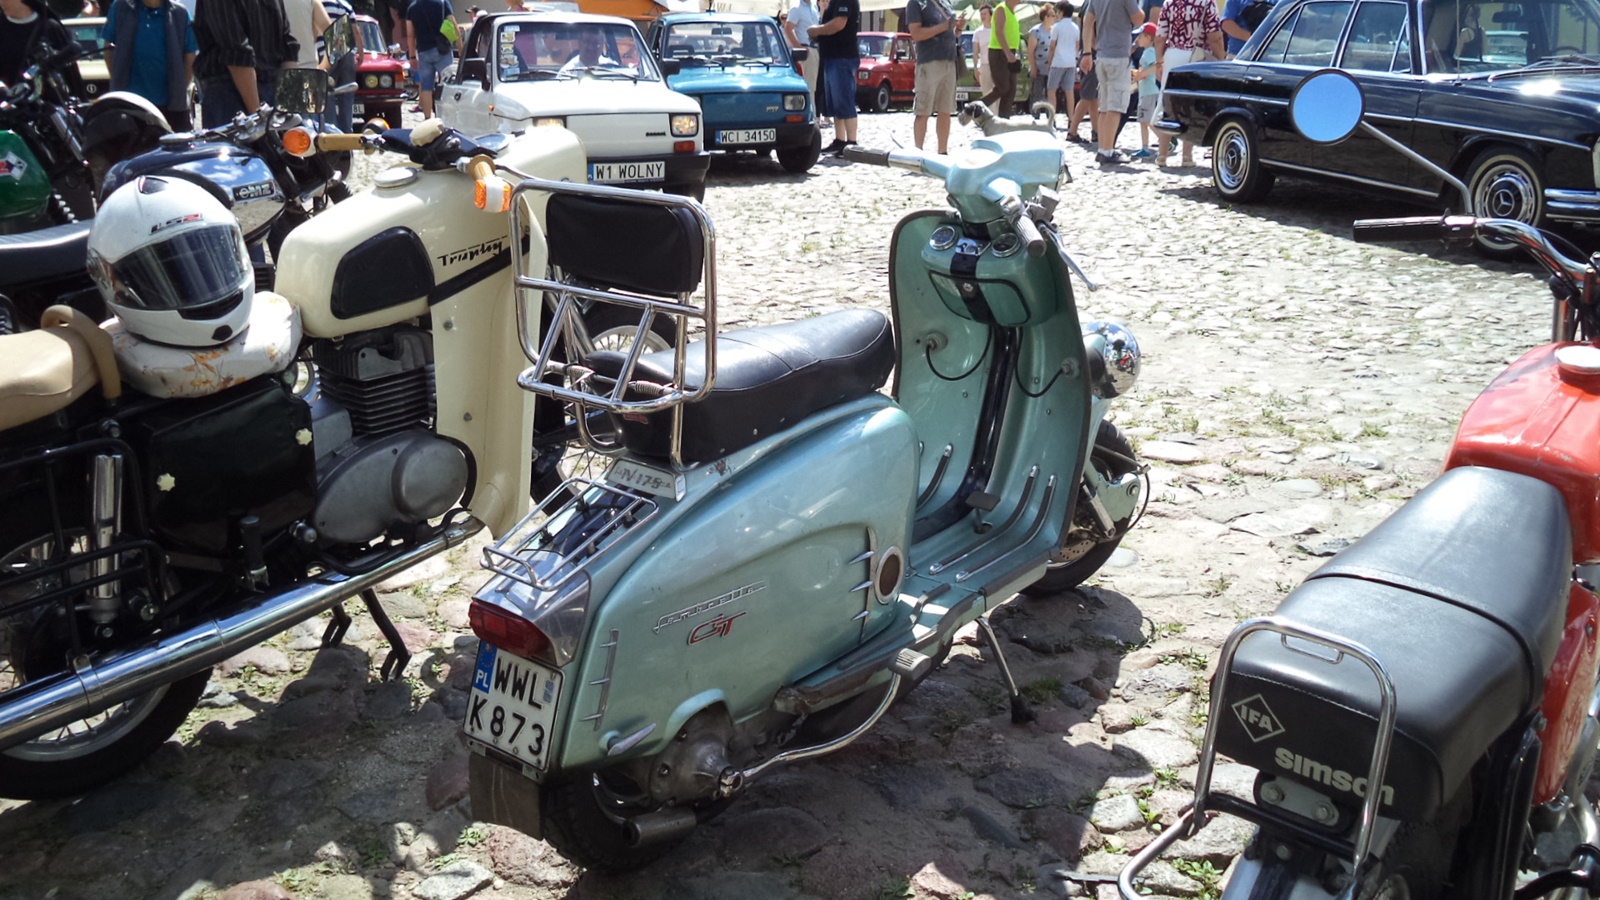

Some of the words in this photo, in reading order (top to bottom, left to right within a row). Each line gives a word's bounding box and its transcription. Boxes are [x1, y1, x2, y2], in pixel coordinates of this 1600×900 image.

[721, 131, 739, 143] WCI
[744, 129, 775, 142] 34150
[596, 165, 611, 179] W1
[619, 163, 663, 179] WOLNY
[687, 612, 747, 645] GT
[475, 669, 489, 688] PL
[494, 658, 542, 710] WWL
[469, 694, 545, 756] K873
[1240, 704, 1273, 733] IFA
